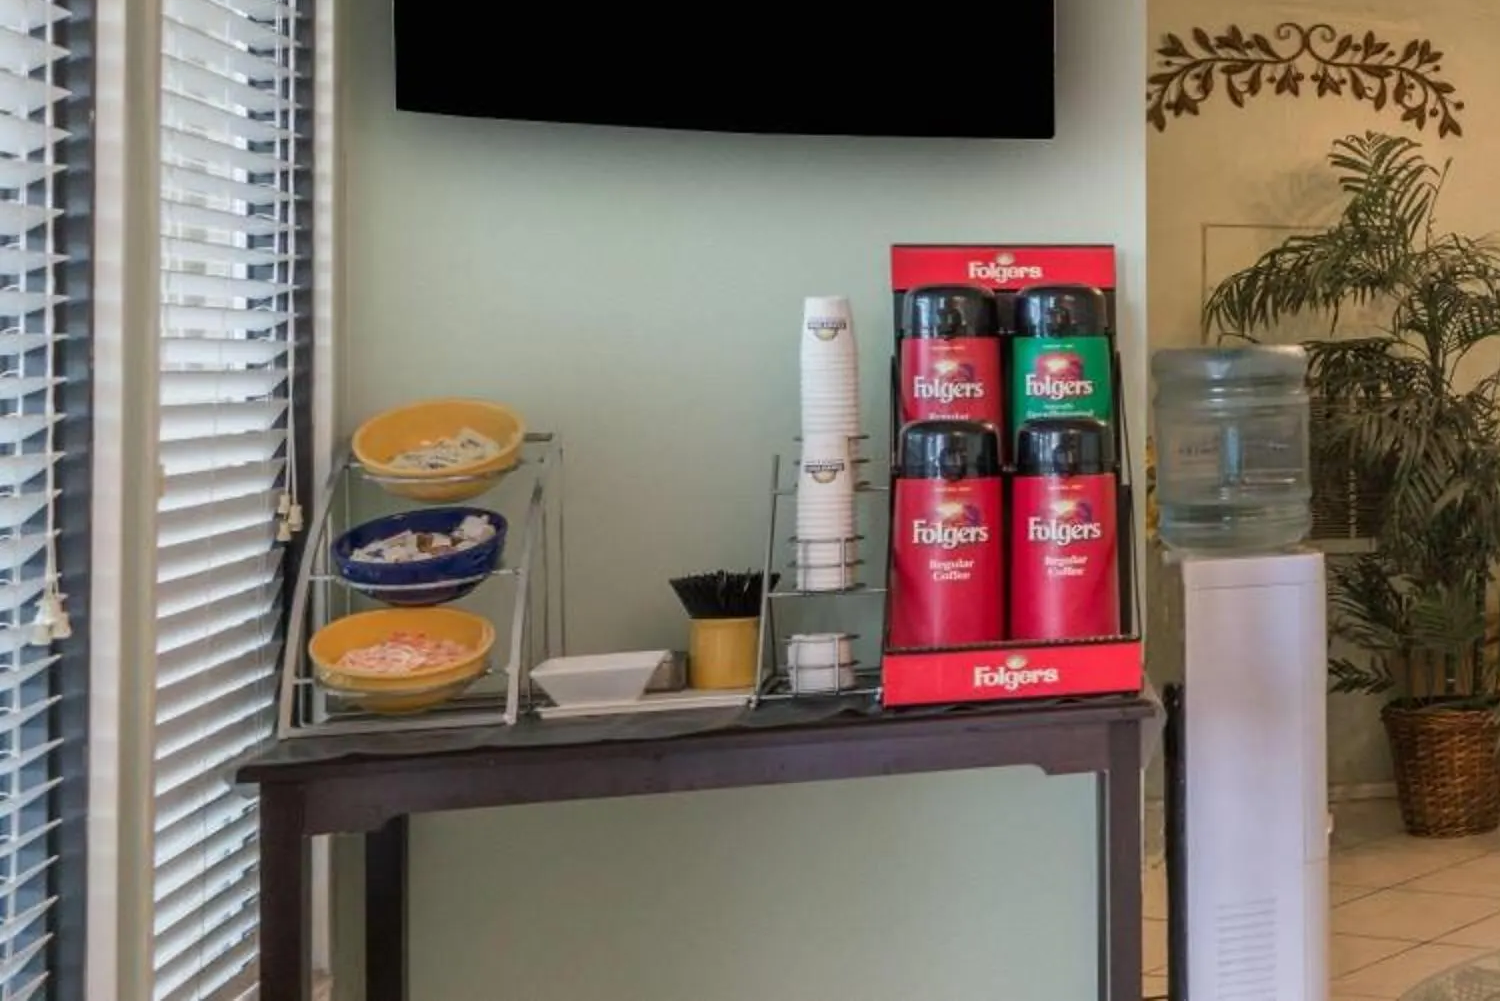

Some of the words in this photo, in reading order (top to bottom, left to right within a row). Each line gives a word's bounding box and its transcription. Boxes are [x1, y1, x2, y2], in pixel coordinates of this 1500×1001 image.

[967, 261, 1042, 284] Folgers
[913, 375, 985, 403] Folgers
[1025, 373, 1093, 400] Folgers
[912, 518, 989, 549] Folgers
[1028, 516, 1101, 546] Folgers
[929, 559, 975, 570] Regular
[932, 570, 971, 581] Coffee
[974, 665, 1059, 691] Folgers
